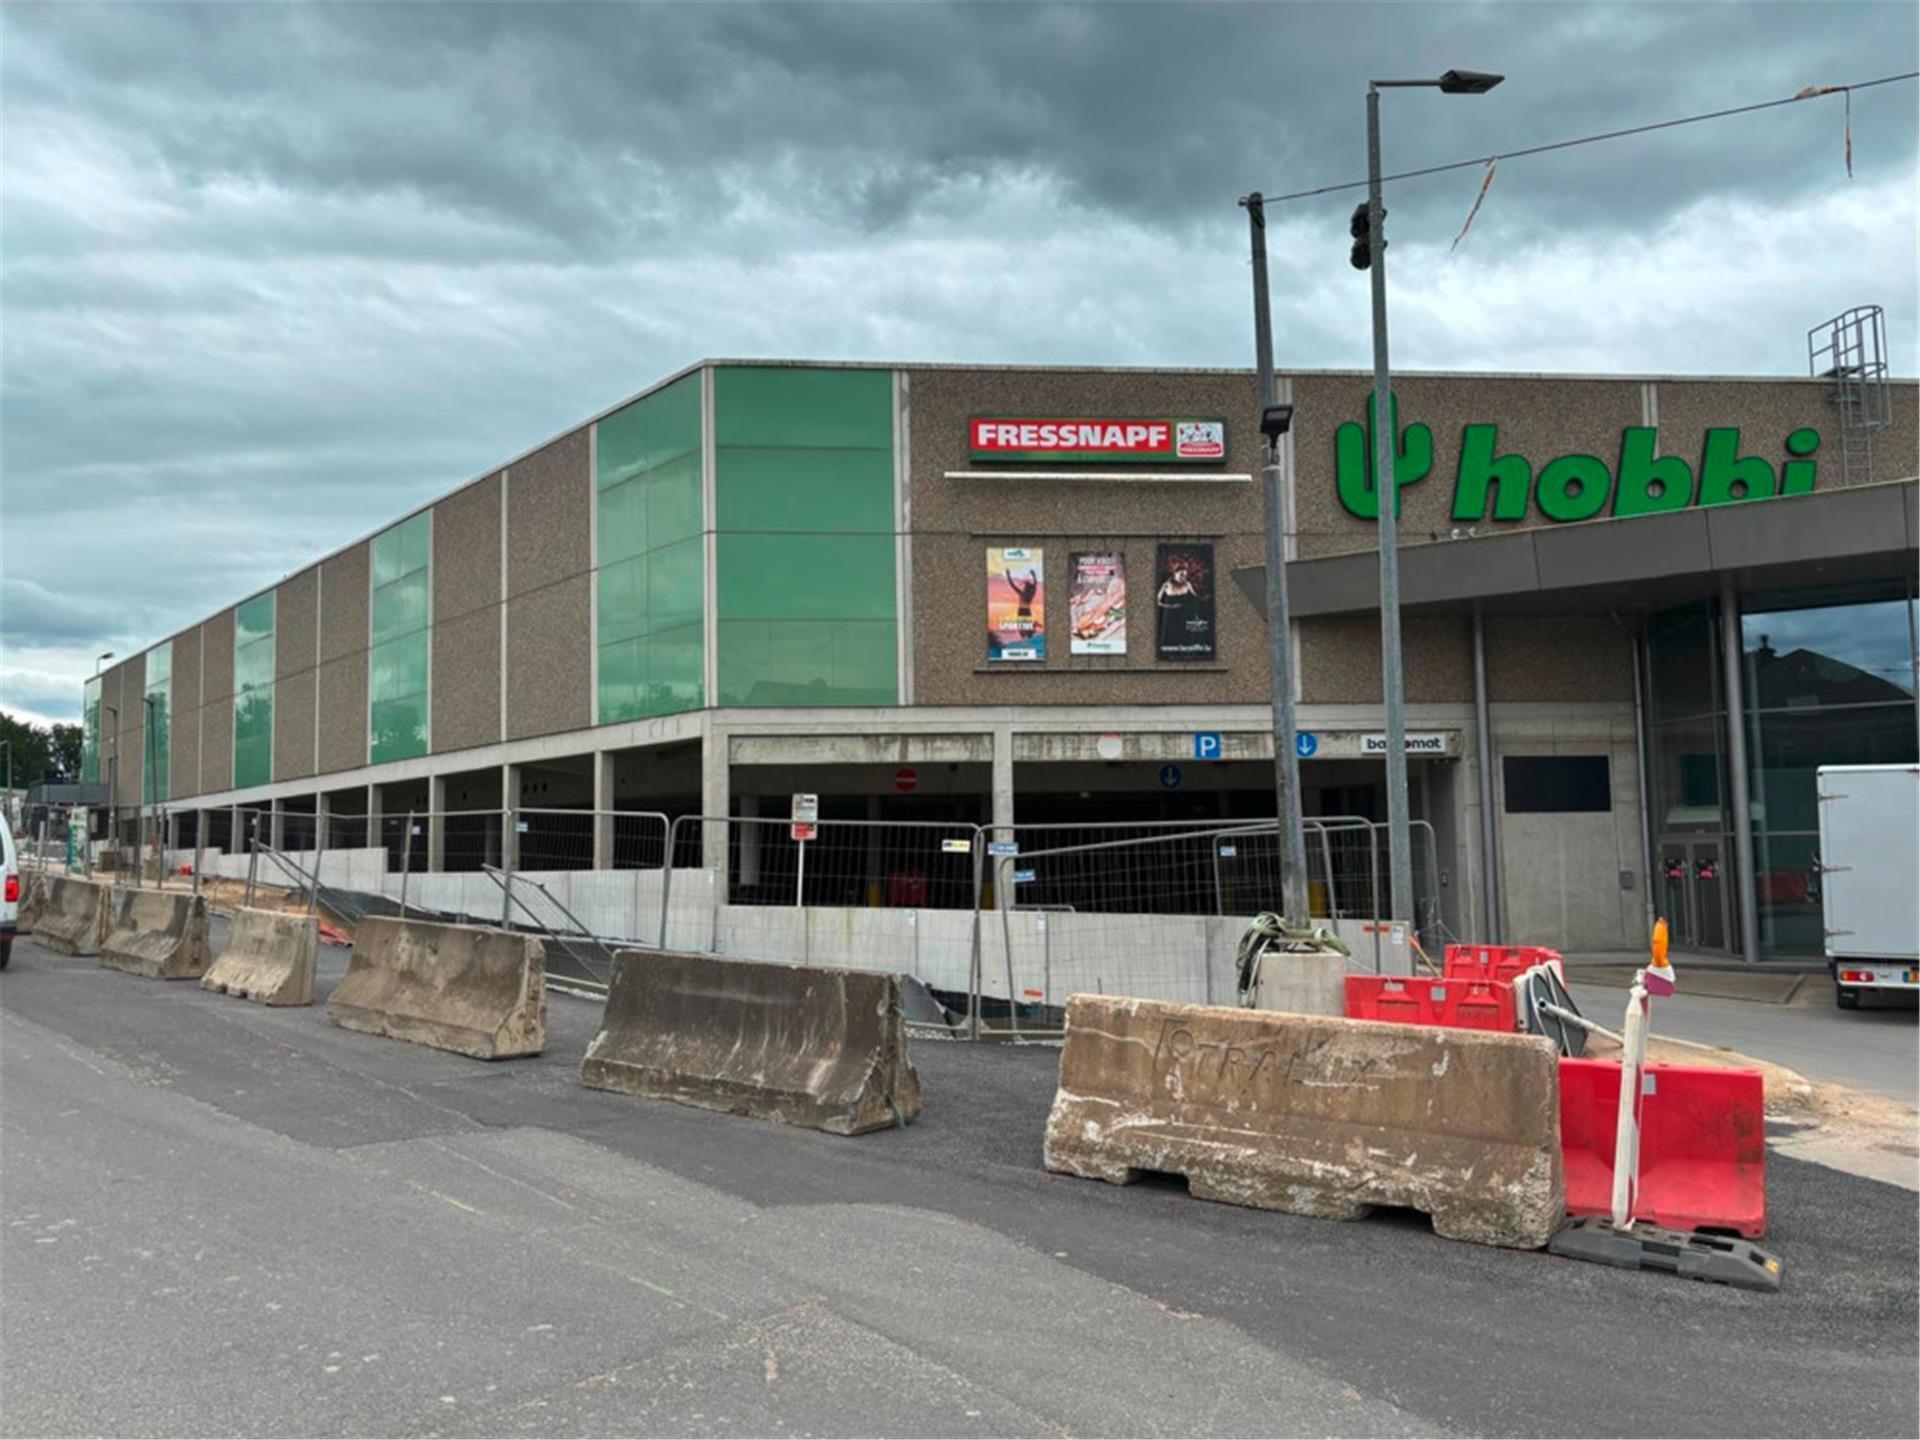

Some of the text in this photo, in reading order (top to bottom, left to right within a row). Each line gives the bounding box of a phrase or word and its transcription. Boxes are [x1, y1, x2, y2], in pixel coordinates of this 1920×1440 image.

[978, 424, 1167, 448] FRESSNAPF
[1451, 424, 1821, 522] hobbi
[1200, 736, 1216, 757] P
